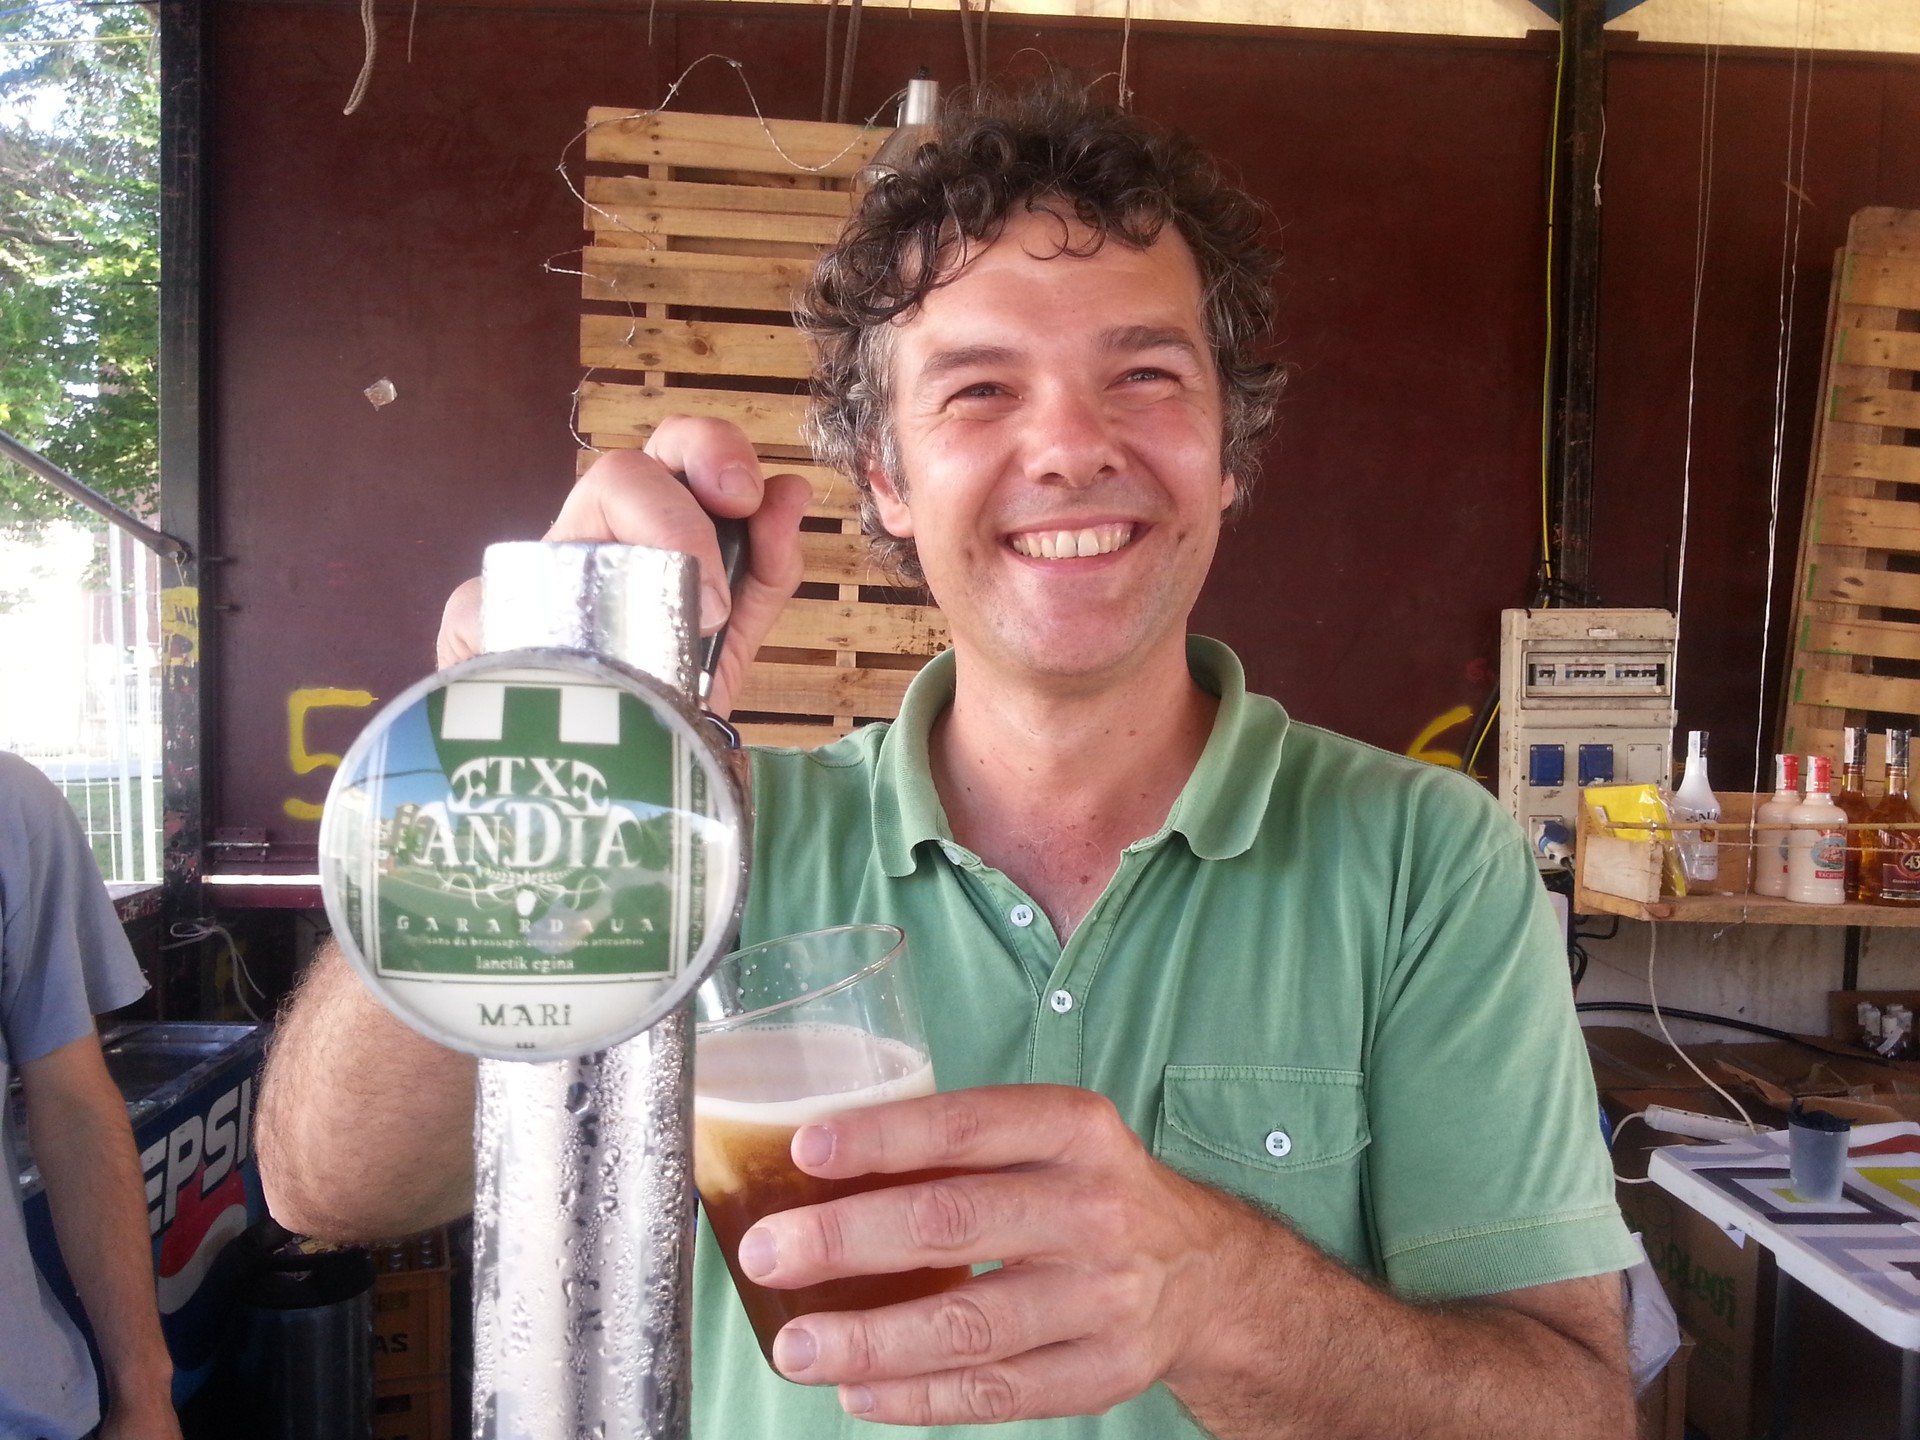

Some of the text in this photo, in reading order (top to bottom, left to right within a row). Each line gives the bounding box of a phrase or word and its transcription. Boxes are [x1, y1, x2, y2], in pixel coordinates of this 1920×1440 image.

[412, 800, 643, 869] ANDIA
[1904, 854, 1920, 870] 43
[532, 956, 574, 973] egina
